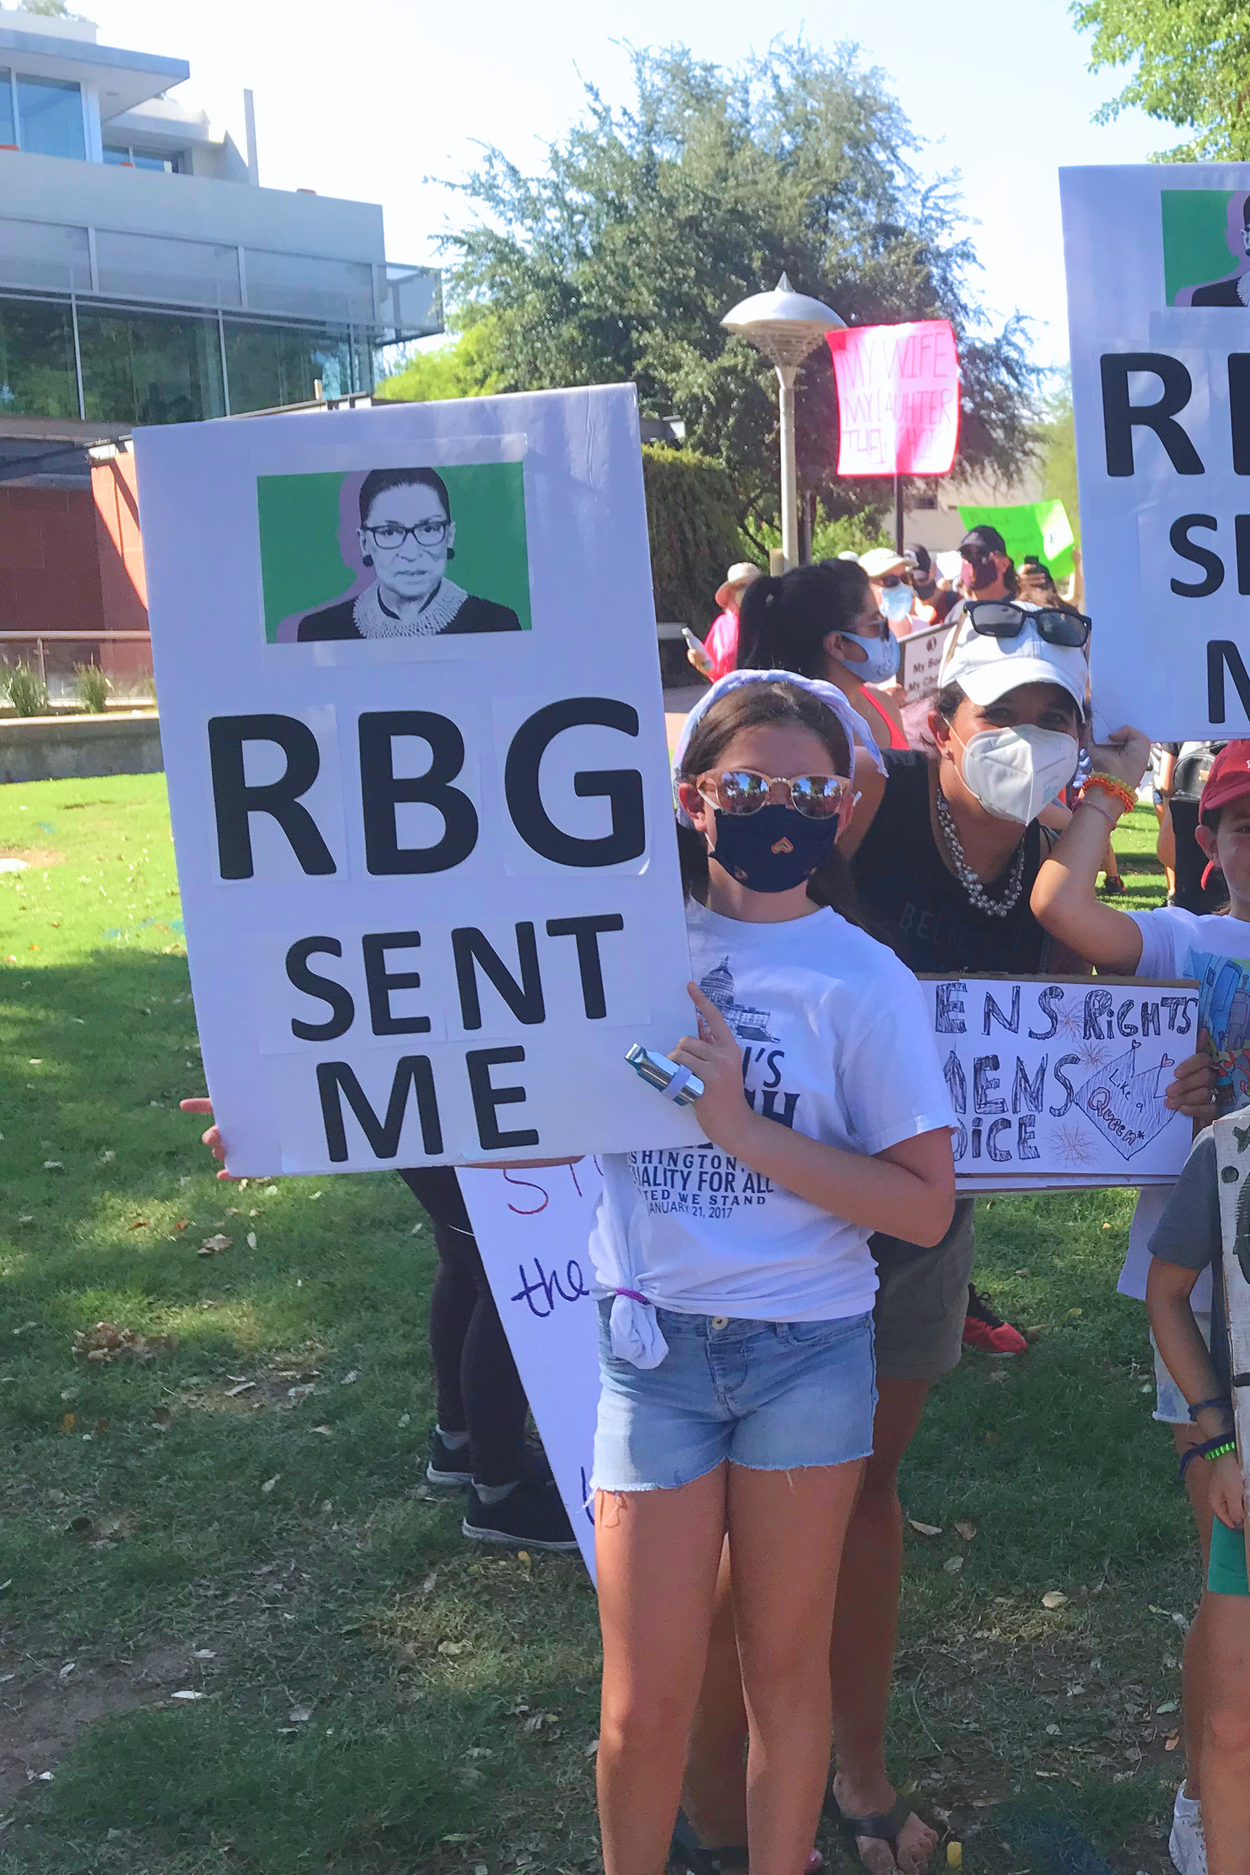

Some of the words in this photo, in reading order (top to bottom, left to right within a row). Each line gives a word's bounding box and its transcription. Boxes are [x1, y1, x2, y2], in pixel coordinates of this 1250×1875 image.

[882, 333, 949, 379] WIFE
[844, 393, 873, 427] MY
[208, 697, 645, 880] RBG
[286, 914, 624, 1041] SENT
[935, 982, 1064, 1040] ENS
[316, 1046, 539, 1166] ME
[633, 1165, 692, 1192] ALITY
[697, 1171, 736, 1194] FOR
[742, 1172, 775, 1194] ALL
[638, 1187, 671, 1201] TED
[678, 1192, 700, 1206] WE
[709, 1195, 766, 1206] STAND
[692, 1206, 706, 1219] 21,
[708, 1207, 733, 1219] 2017
